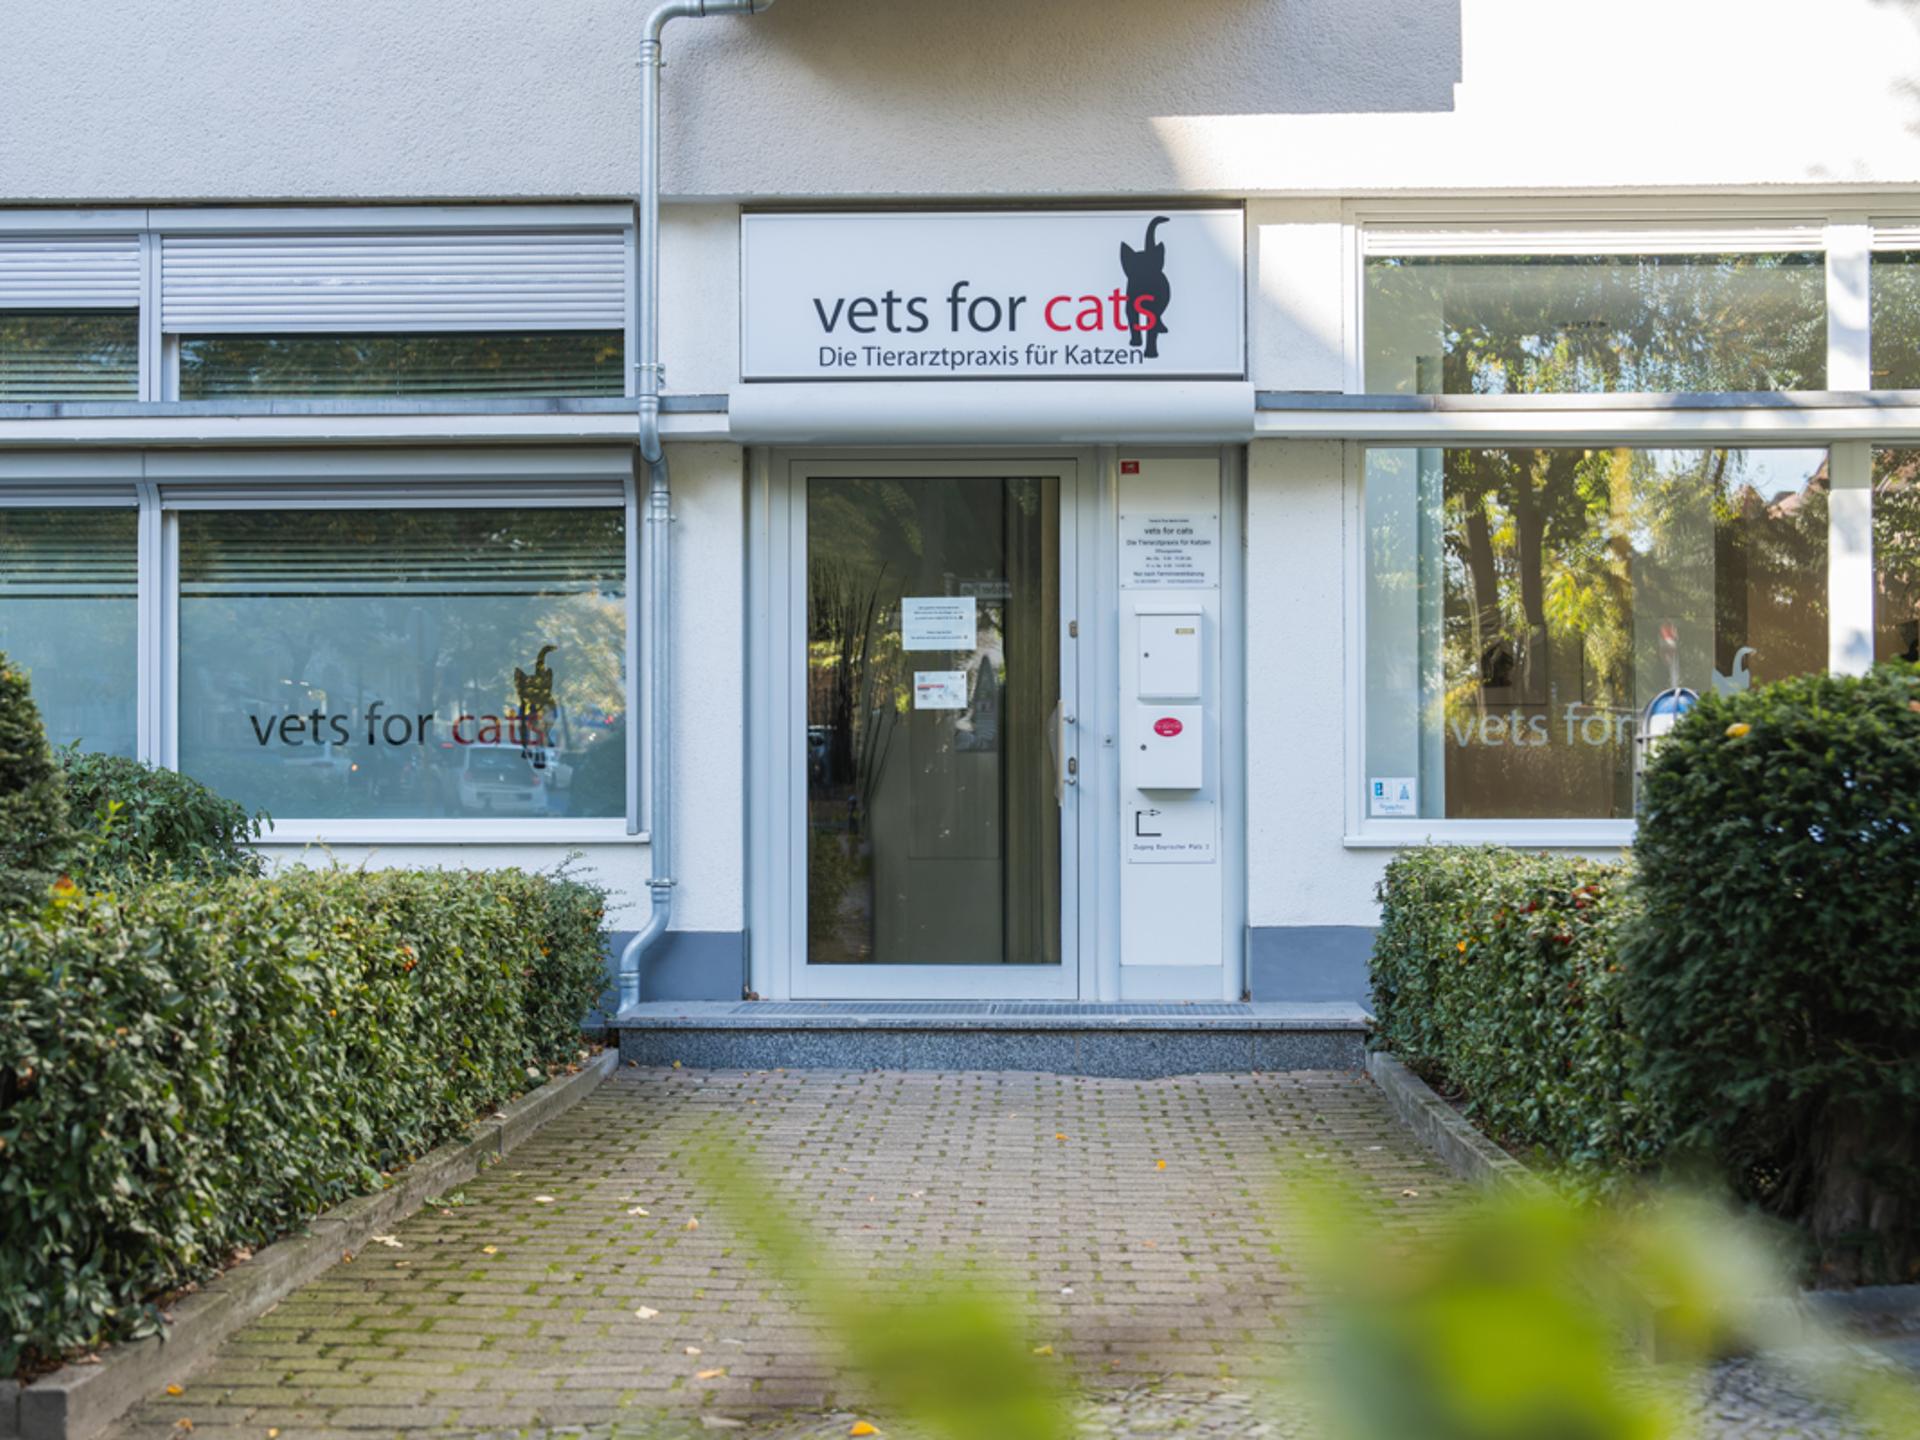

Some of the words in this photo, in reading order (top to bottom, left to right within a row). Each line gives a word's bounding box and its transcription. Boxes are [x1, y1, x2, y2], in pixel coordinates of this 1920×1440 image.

[812, 289, 929, 333] vets
[946, 280, 1027, 333] for
[1043, 288, 1157, 332] cats
[819, 346, 857, 367] Die
[862, 345, 1019, 370] Tierarztpraxis
[1025, 343, 1058, 365] für
[1065, 344, 1144, 365] Katzen
[1143, 527, 1161, 535] vets
[1163, 526, 1174, 535] for
[250, 708, 350, 746] vets
[365, 700, 433, 746] for
[452, 709, 545, 746] cats
[1450, 708, 1549, 747] vets
[1563, 701, 1632, 746] for
